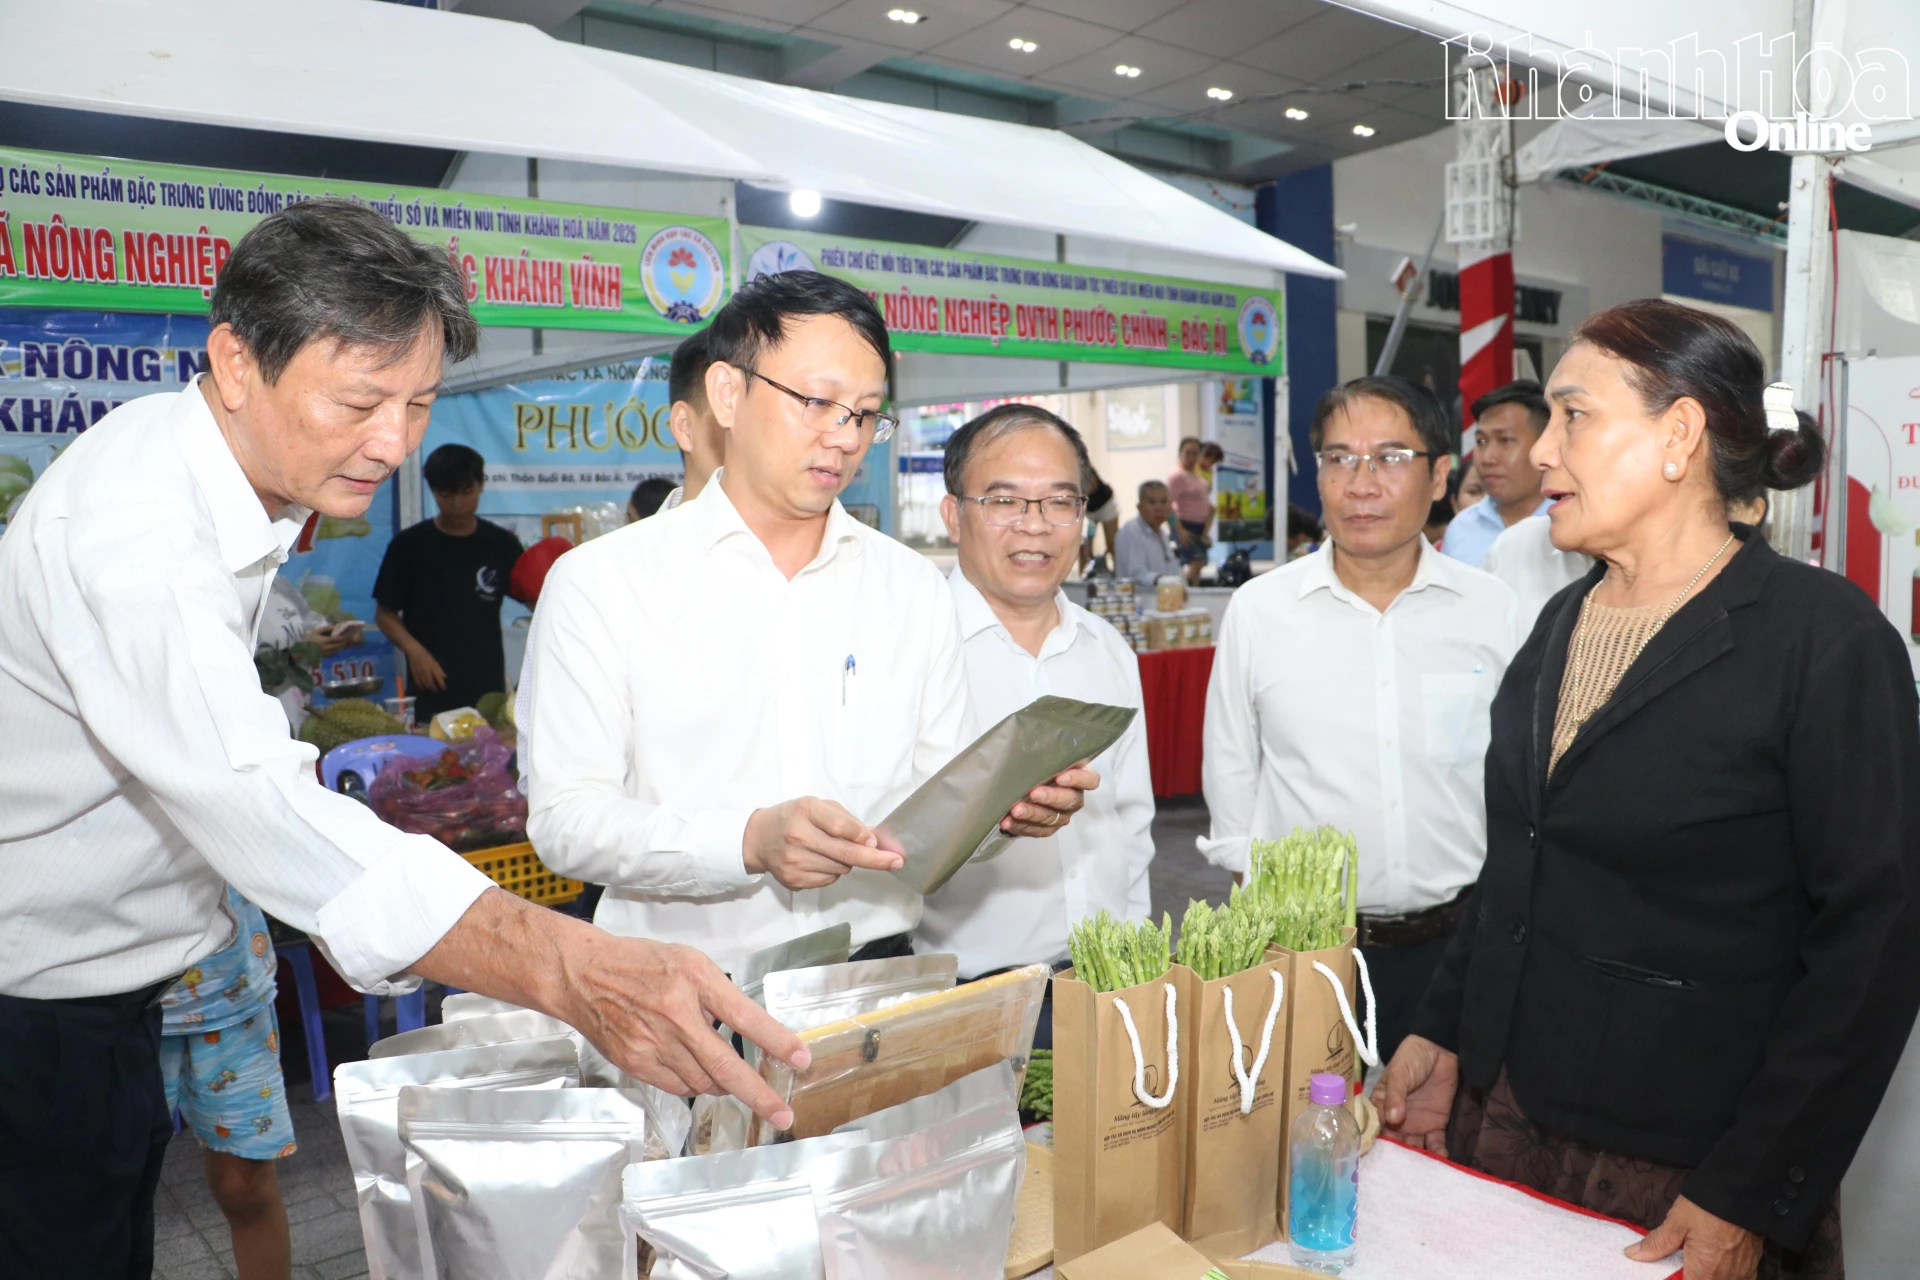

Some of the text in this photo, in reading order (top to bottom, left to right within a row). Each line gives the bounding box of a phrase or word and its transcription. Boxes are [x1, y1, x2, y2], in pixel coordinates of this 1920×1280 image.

[9, 164, 41, 195] CÁC
[45, 164, 77, 199] SẢN
[80, 167, 124, 203] PHẨM
[127, 175, 156, 209] ĐẶC
[160, 182, 205, 210] TRƯNG
[208, 181, 244, 212] VÙNG
[248, 183, 282, 215] ĐỒNG
[406, 196, 421, 226] SỐ
[424, 202, 440, 228] VÀ
[497, 204, 521, 233] TỈNH
[524, 210, 560, 237] KHÁNH
[586, 216, 610, 241] NĂM
[613, 222, 638, 244] 2026
[22, 213, 117, 282] NÔNG
[123, 225, 232, 298] NGHIỆP
[485, 249, 563, 305] KHÁNH
[569, 254, 621, 309] VĨNH
[884, 285, 940, 332] NÔNG
[944, 293, 1010, 346] NGHIỆP
[1016, 303, 1060, 340] DVTH
[1063, 303, 1118, 345] PHƯỚC
[24, 338, 162, 382] NÔNG
[513, 395, 680, 452] PHƯỚC
[333, 661, 374, 682] 510
